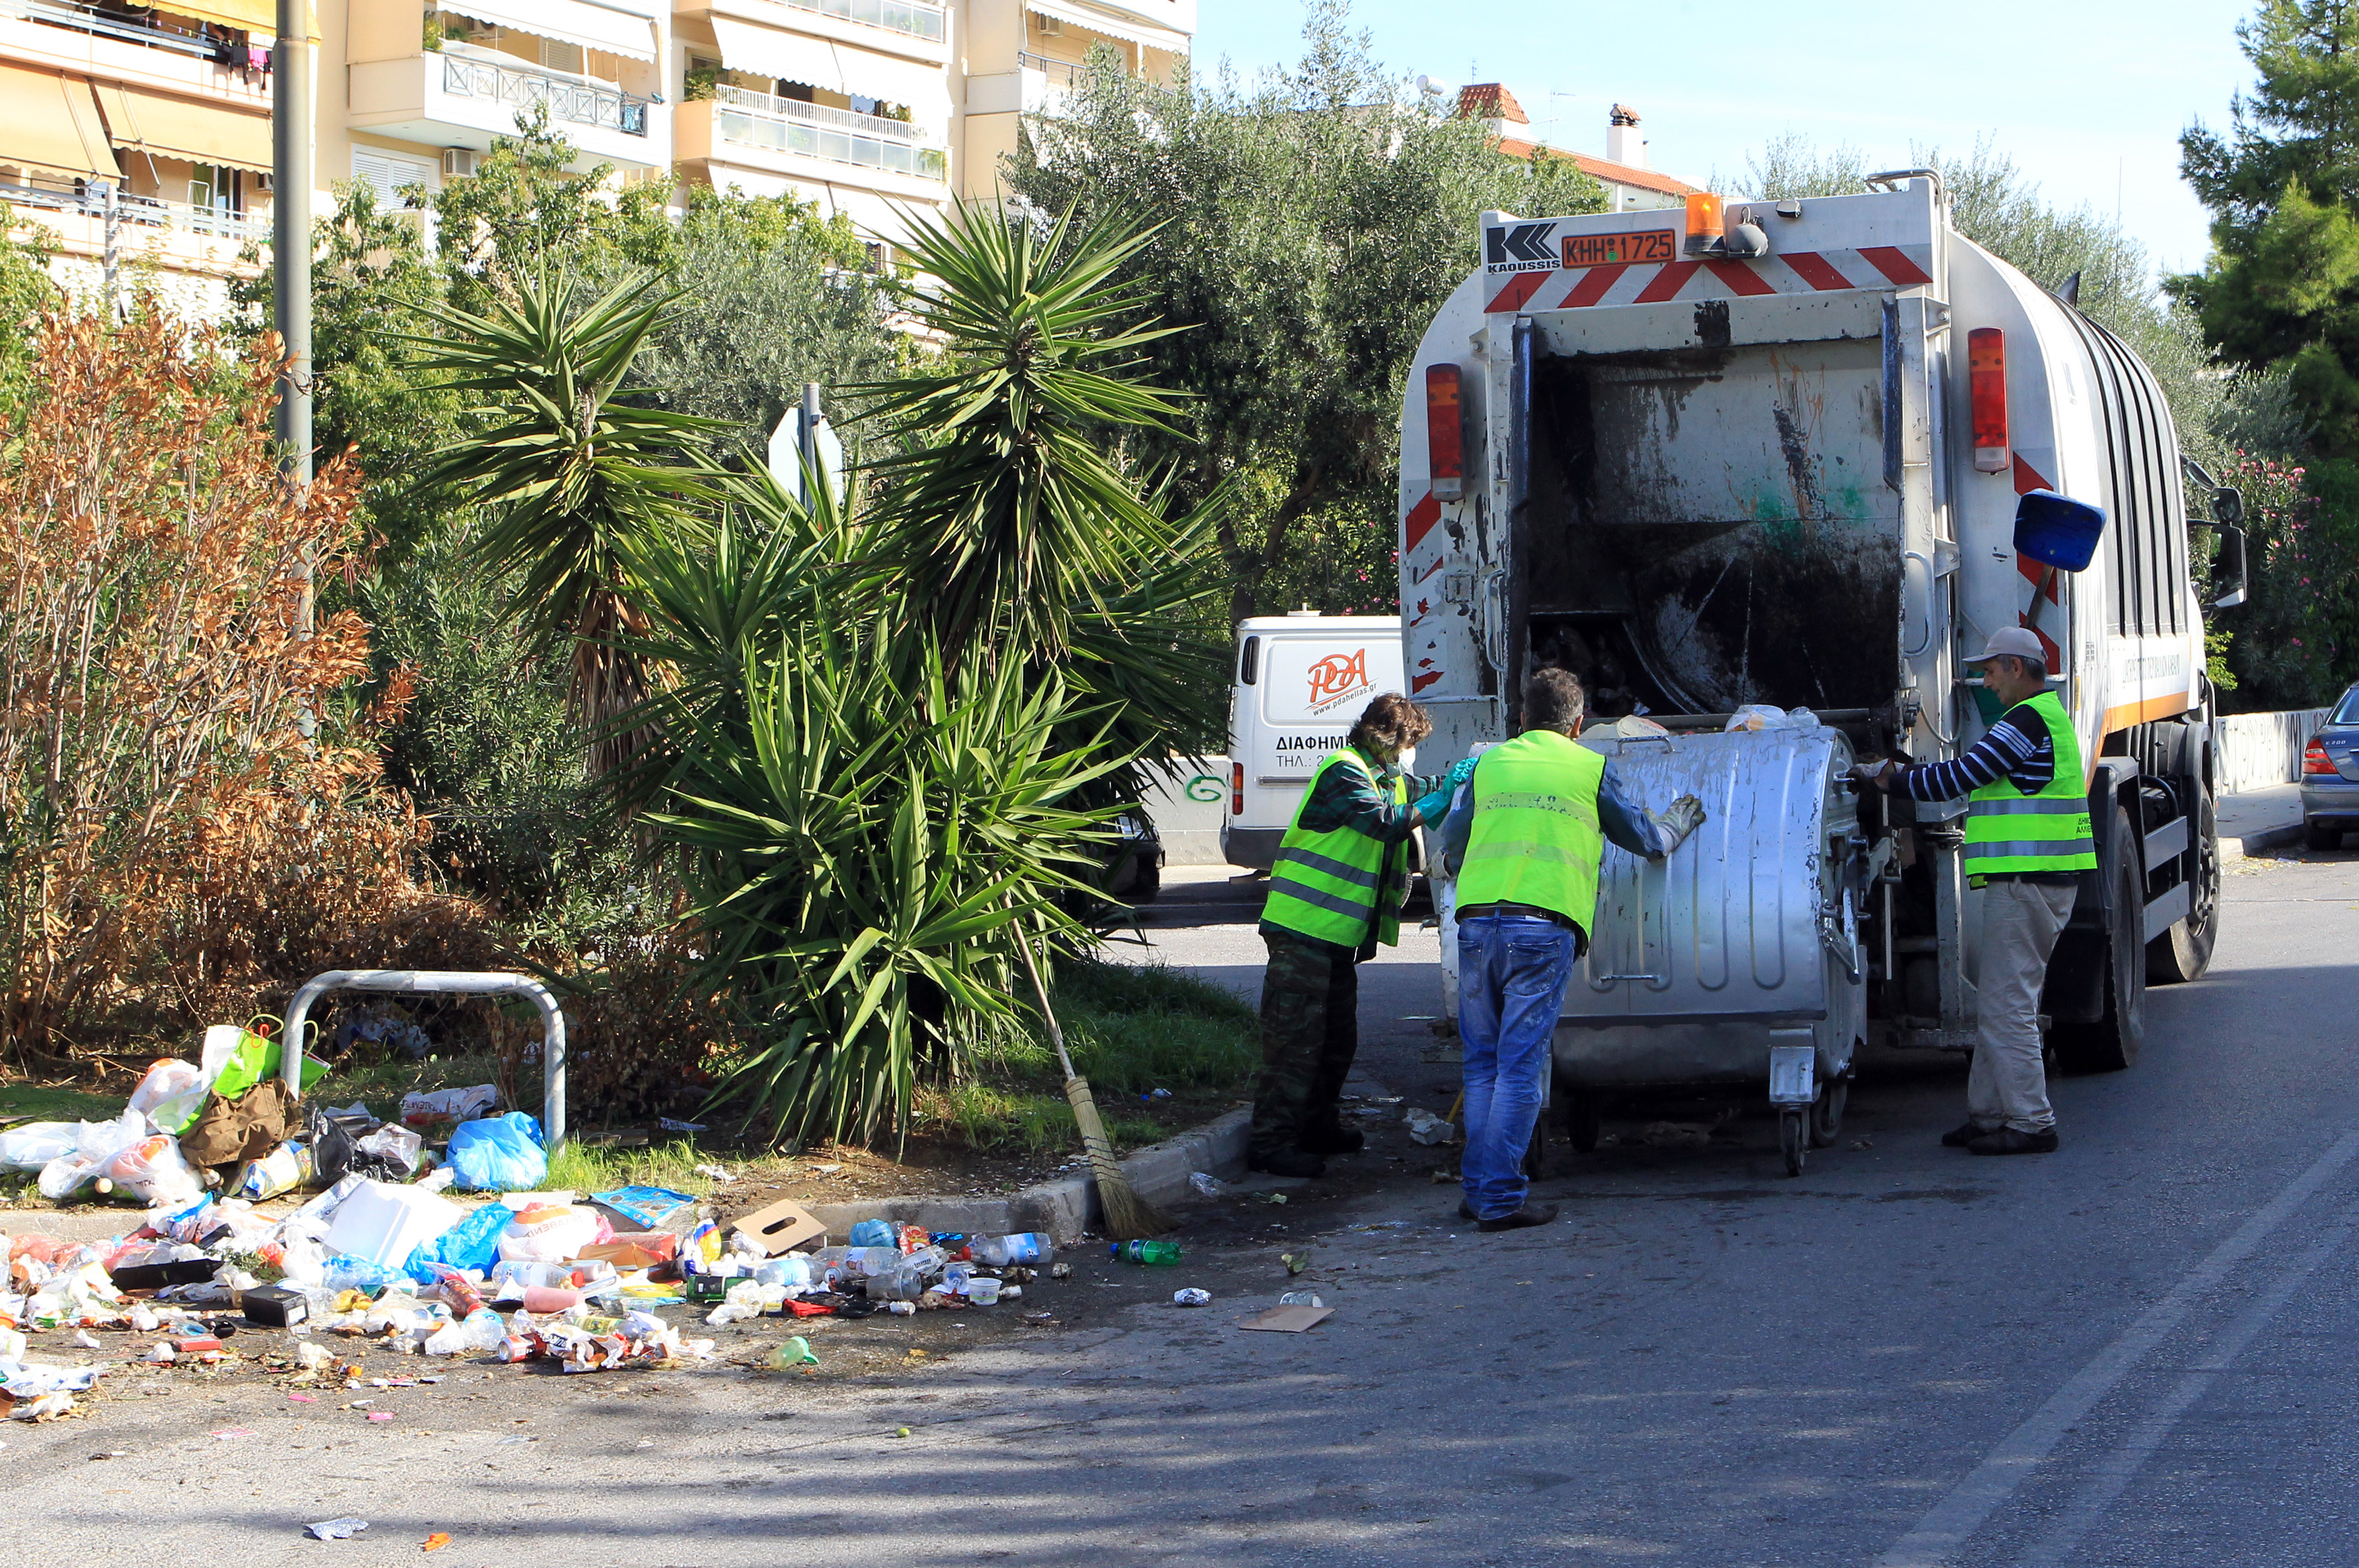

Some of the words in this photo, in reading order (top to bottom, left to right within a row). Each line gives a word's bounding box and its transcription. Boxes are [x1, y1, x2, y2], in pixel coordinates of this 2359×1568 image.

[1621, 234, 1671, 260] 1725
[1488, 260, 1561, 274] KAOUSSIS
[1313, 682, 1377, 716] www.pdahellas.gr
